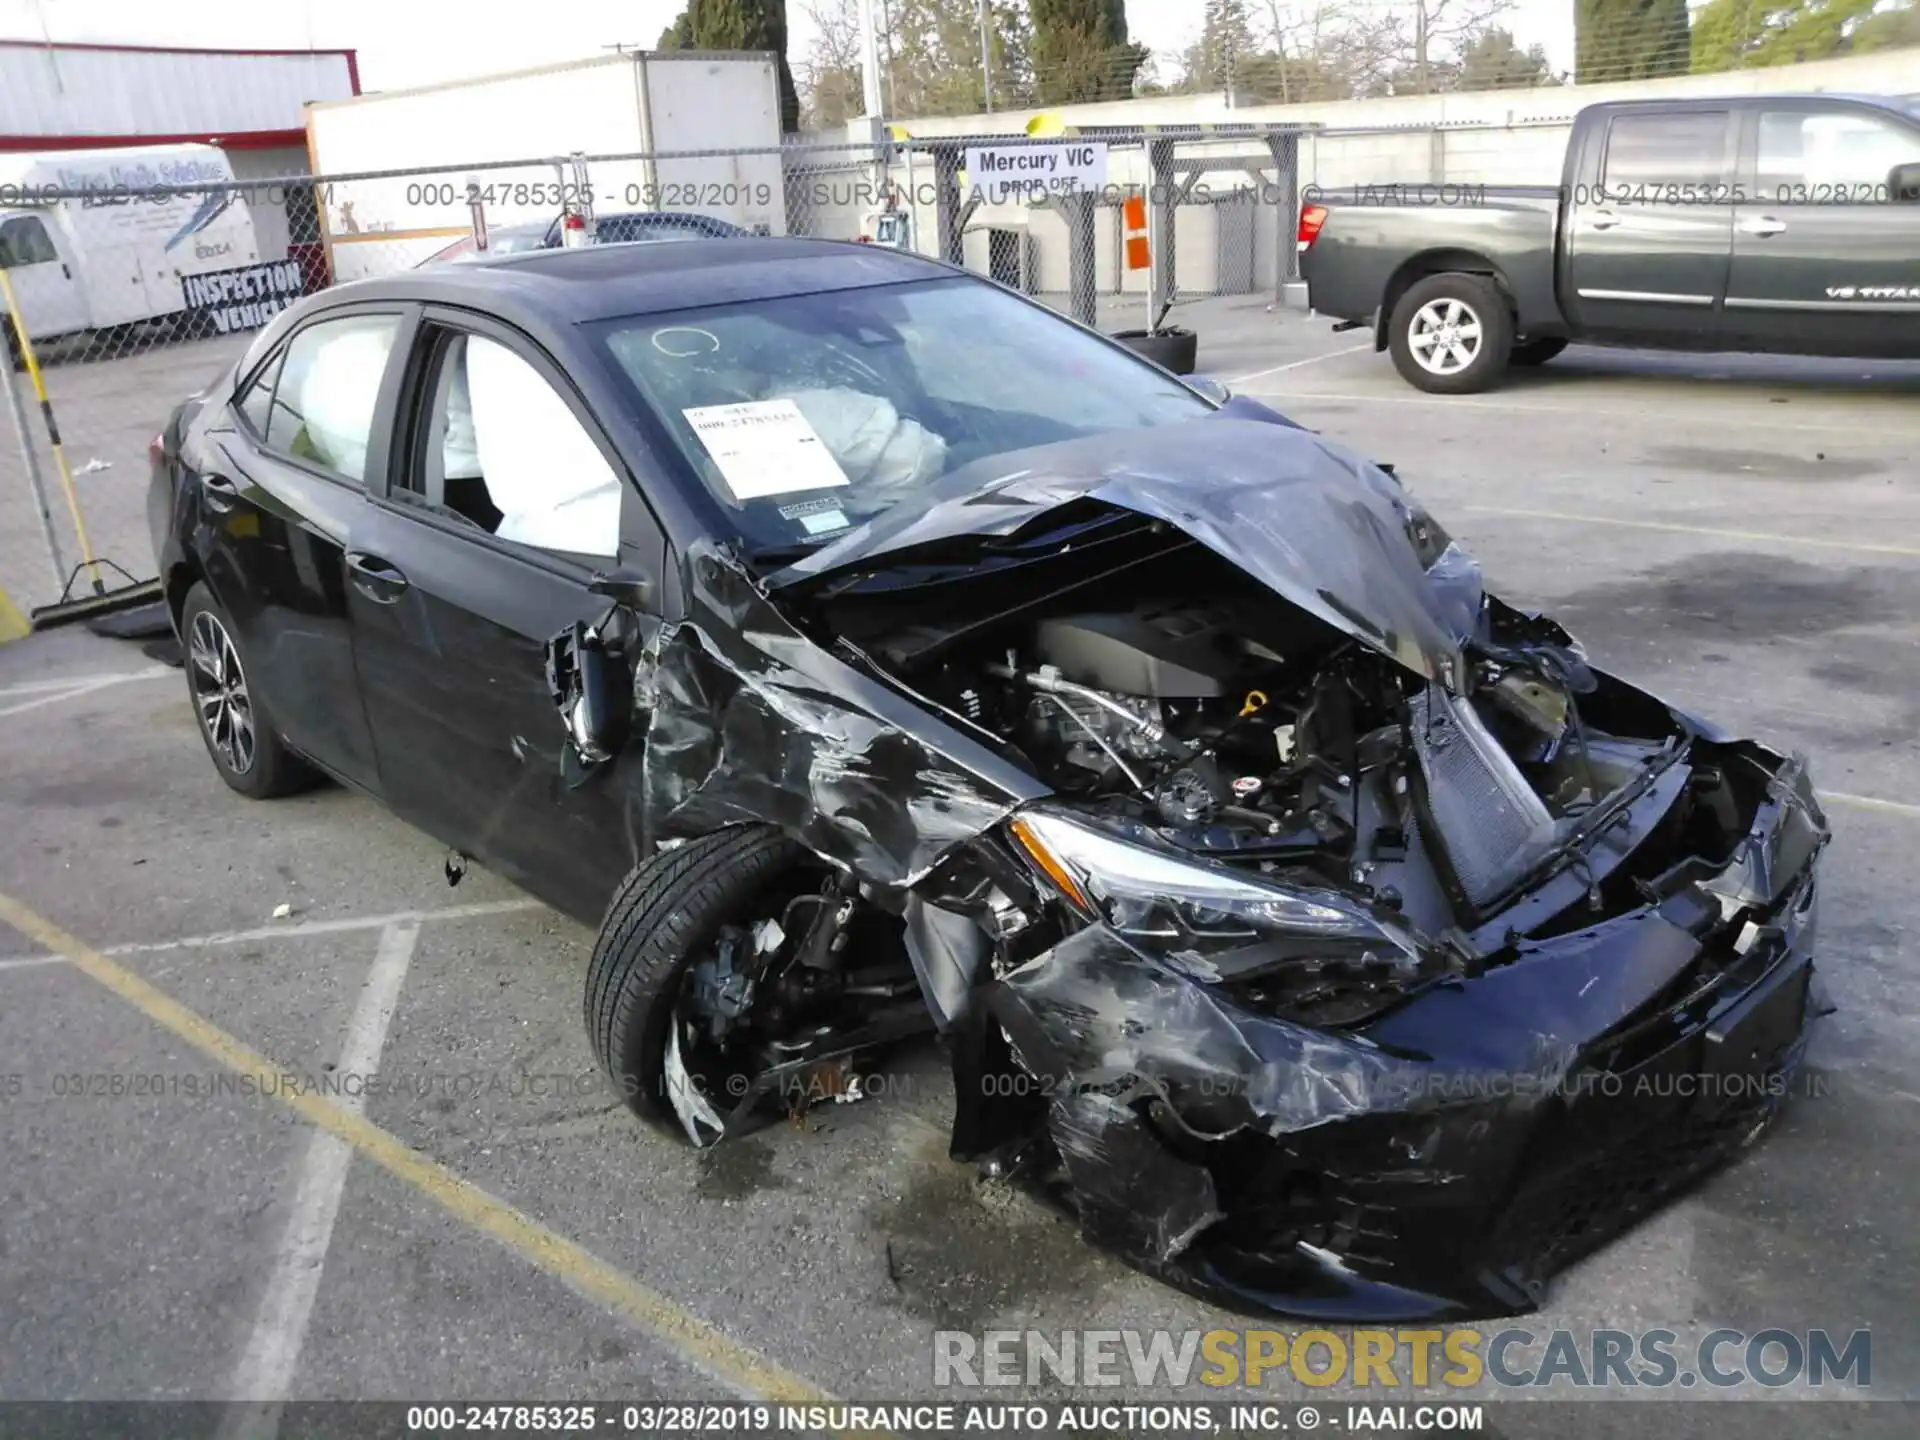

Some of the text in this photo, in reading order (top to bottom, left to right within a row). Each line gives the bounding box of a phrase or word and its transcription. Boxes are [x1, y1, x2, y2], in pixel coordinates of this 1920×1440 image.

[980, 148, 1095, 172] Mercury VIC
[999, 176, 1079, 194] DROP OFF
[186, 262, 302, 309] INSPECTION
